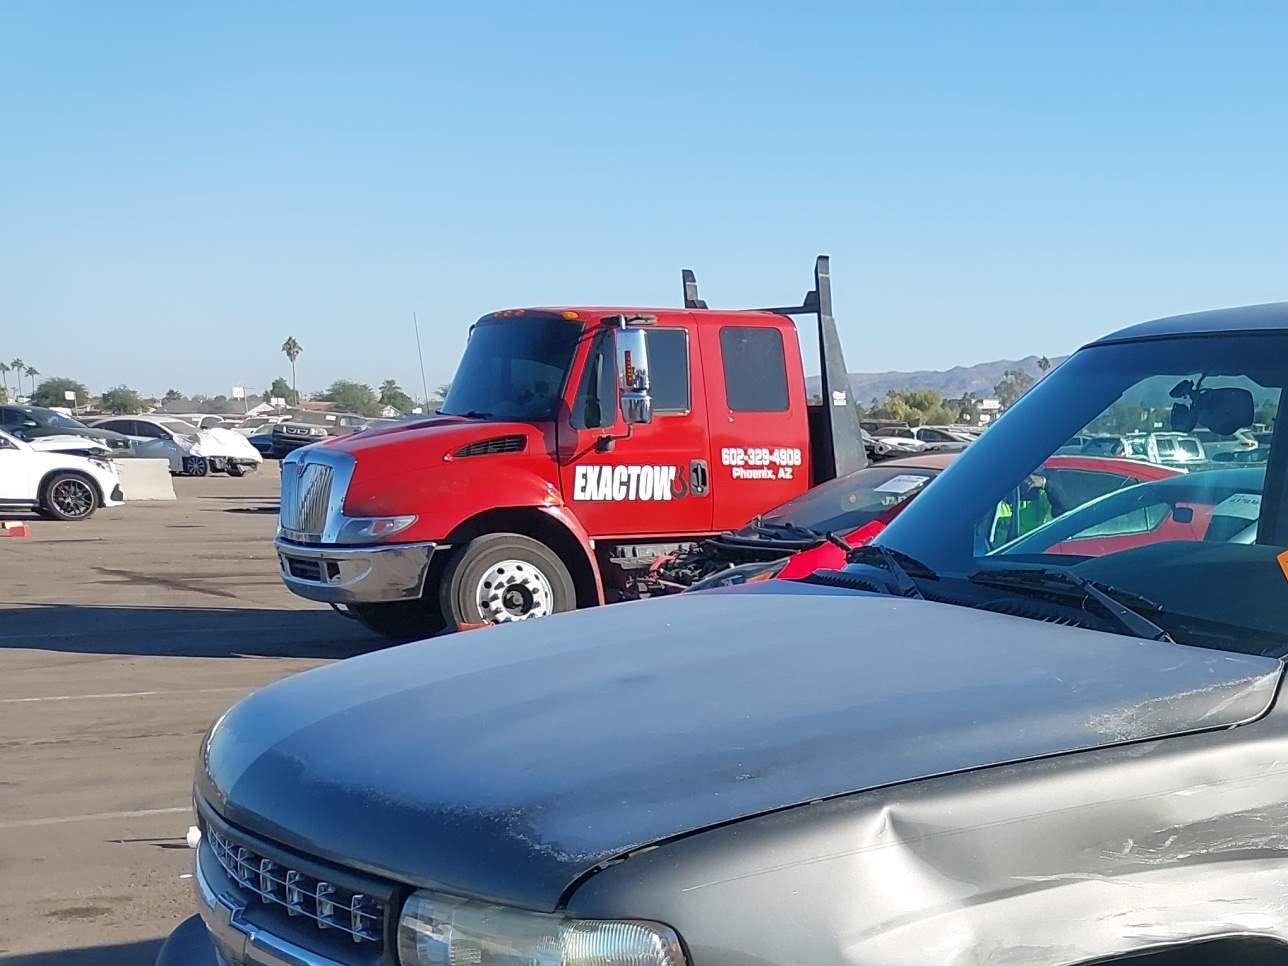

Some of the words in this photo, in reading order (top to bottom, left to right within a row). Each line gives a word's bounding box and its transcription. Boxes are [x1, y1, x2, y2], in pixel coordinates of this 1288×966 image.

[721, 448, 802, 466] 602-329-4908
[732, 467, 776, 480] Phoenix,
[777, 467, 793, 480] AZ
[573, 465, 677, 501] EXACTOW
